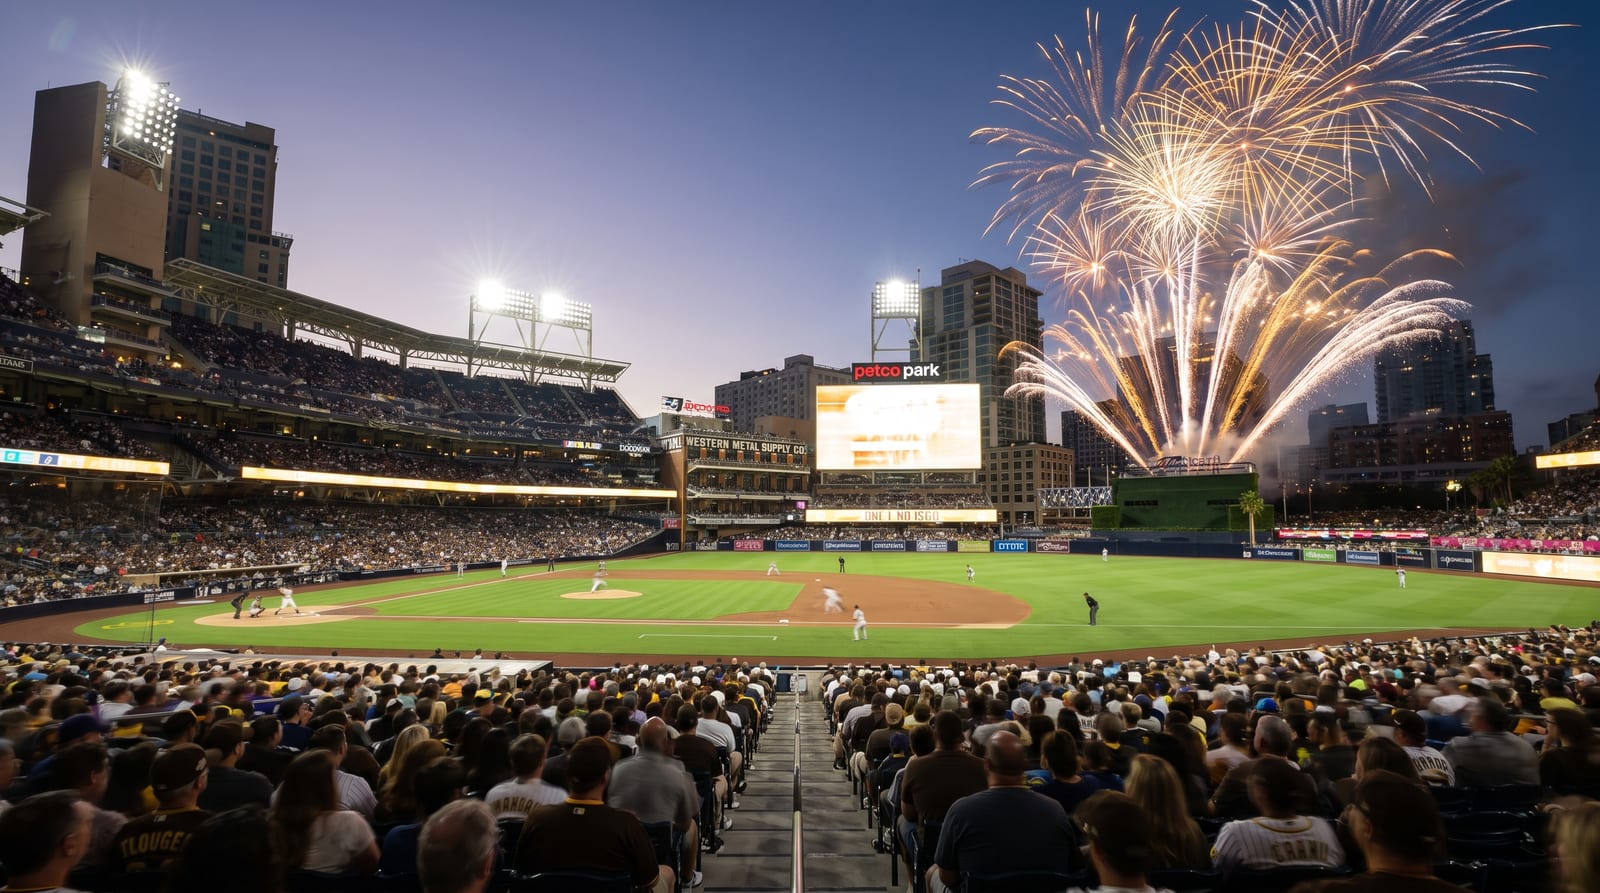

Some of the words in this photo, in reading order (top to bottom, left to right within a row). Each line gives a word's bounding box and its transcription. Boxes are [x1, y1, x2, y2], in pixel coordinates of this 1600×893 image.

[854, 364, 901, 381] petco
[903, 363, 940, 380] park
[686, 436, 729, 449] WESTERN
[732, 440, 760, 452] METAL
[762, 443, 791, 454] SUPPLY
[793, 445, 807, 455] CO.
